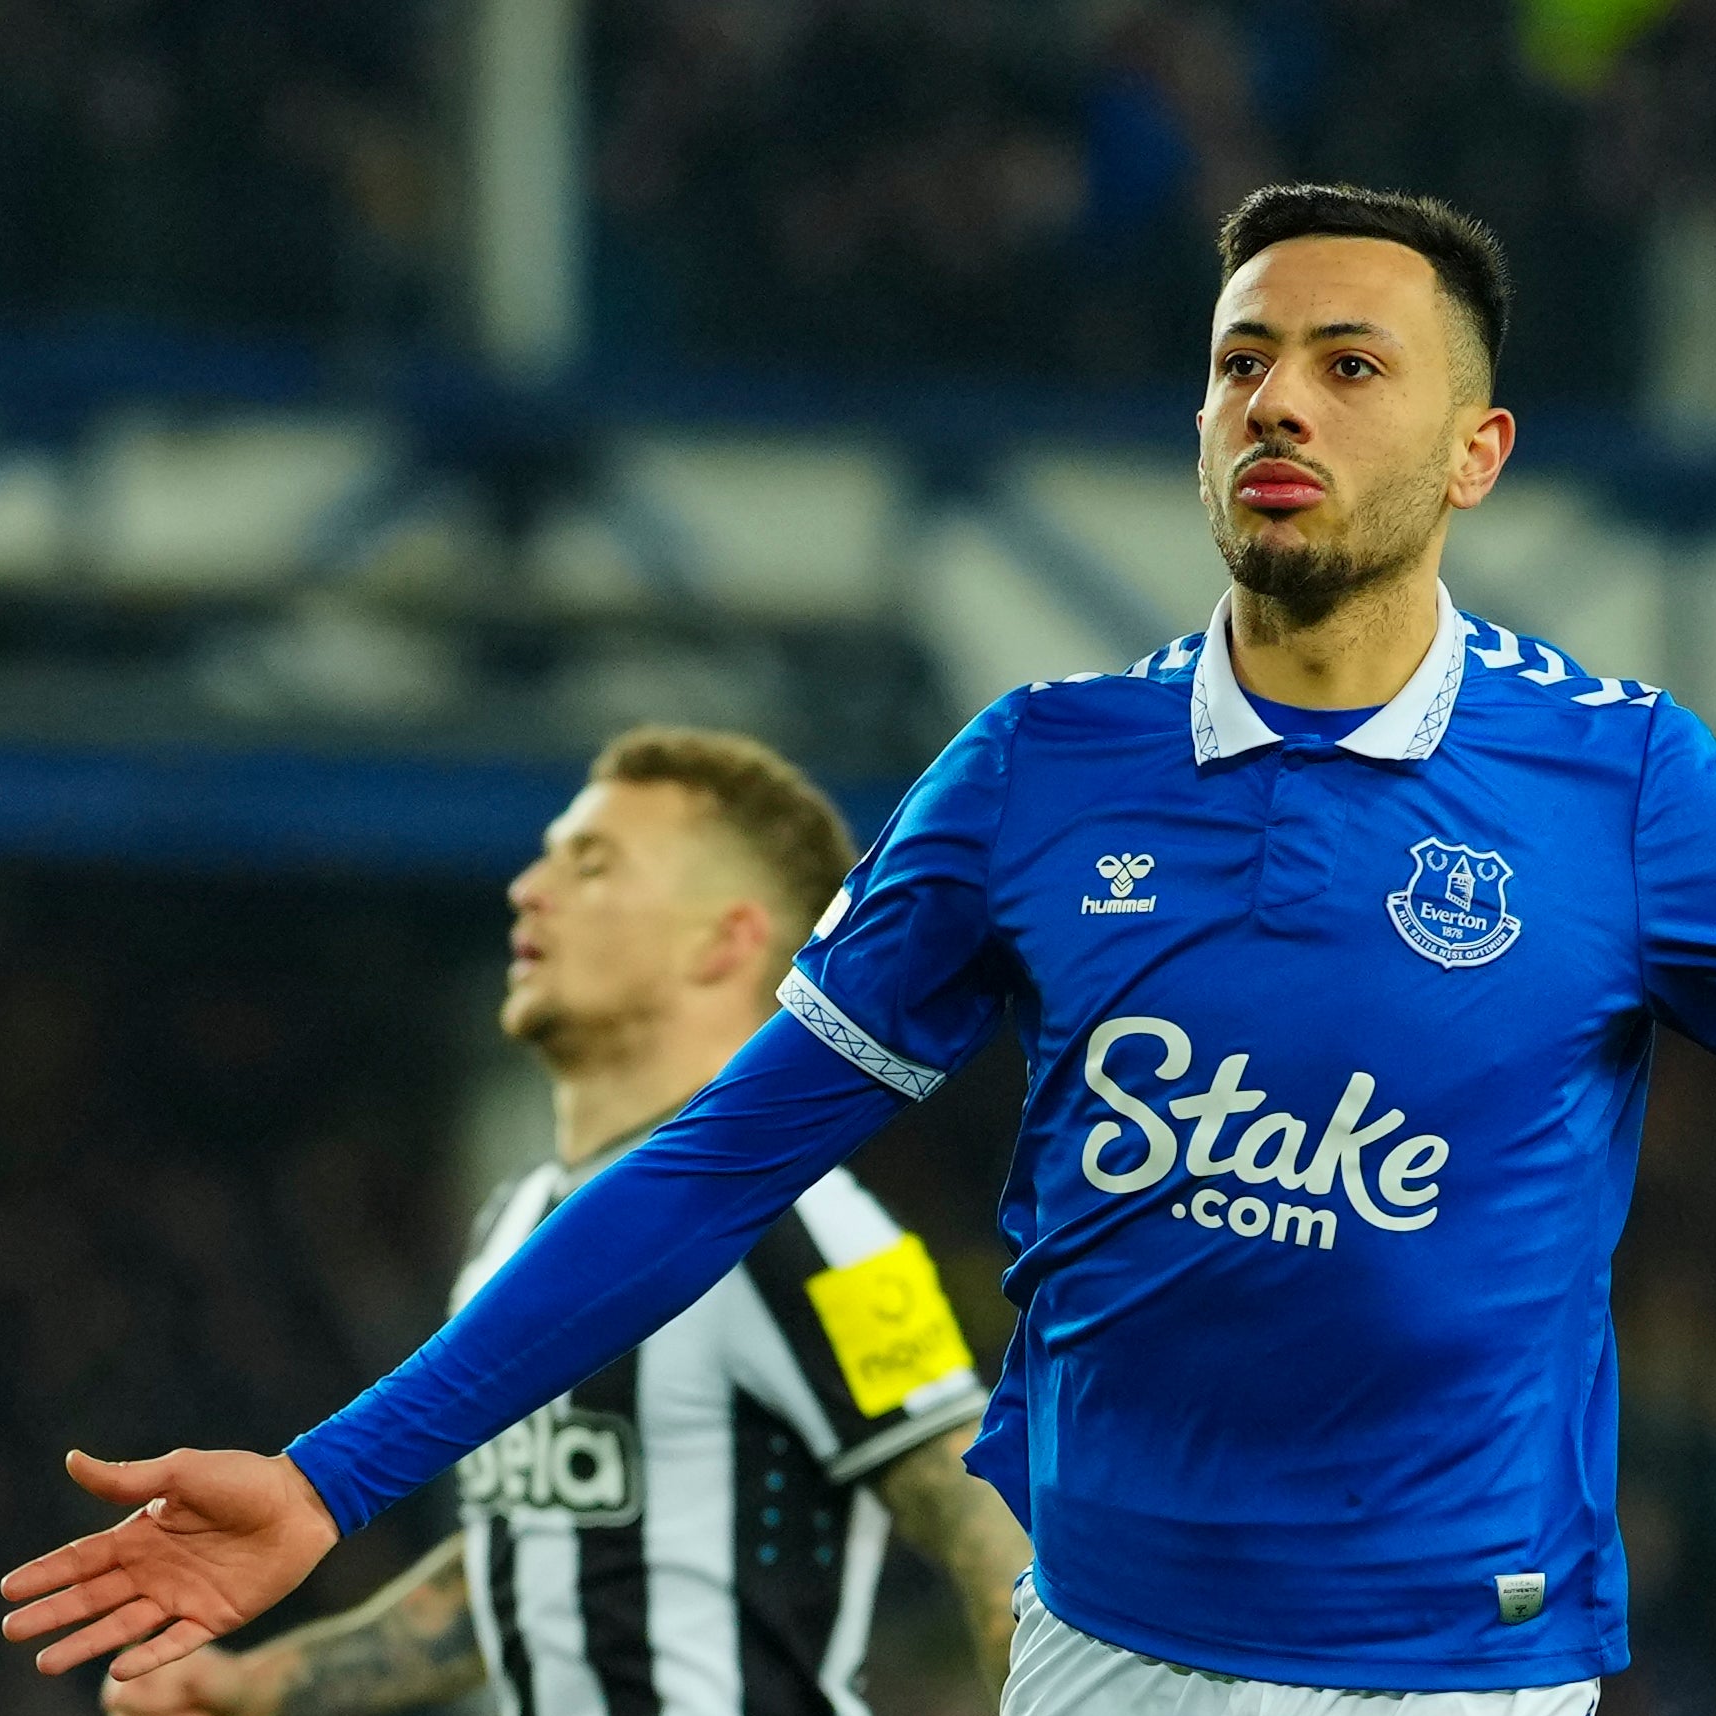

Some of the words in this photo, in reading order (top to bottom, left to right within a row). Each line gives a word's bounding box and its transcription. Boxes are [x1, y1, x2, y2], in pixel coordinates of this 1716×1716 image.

[1081, 895, 1157, 915] hummel
[1421, 902, 1487, 930] Everton
[1411, 929, 1437, 953] SATIS
[1438, 947, 1463, 961] NISI
[1442, 926, 1463, 940] 1878
[1082, 1016, 1449, 1231] Stake
[1171, 1188, 1337, 1250] .com
